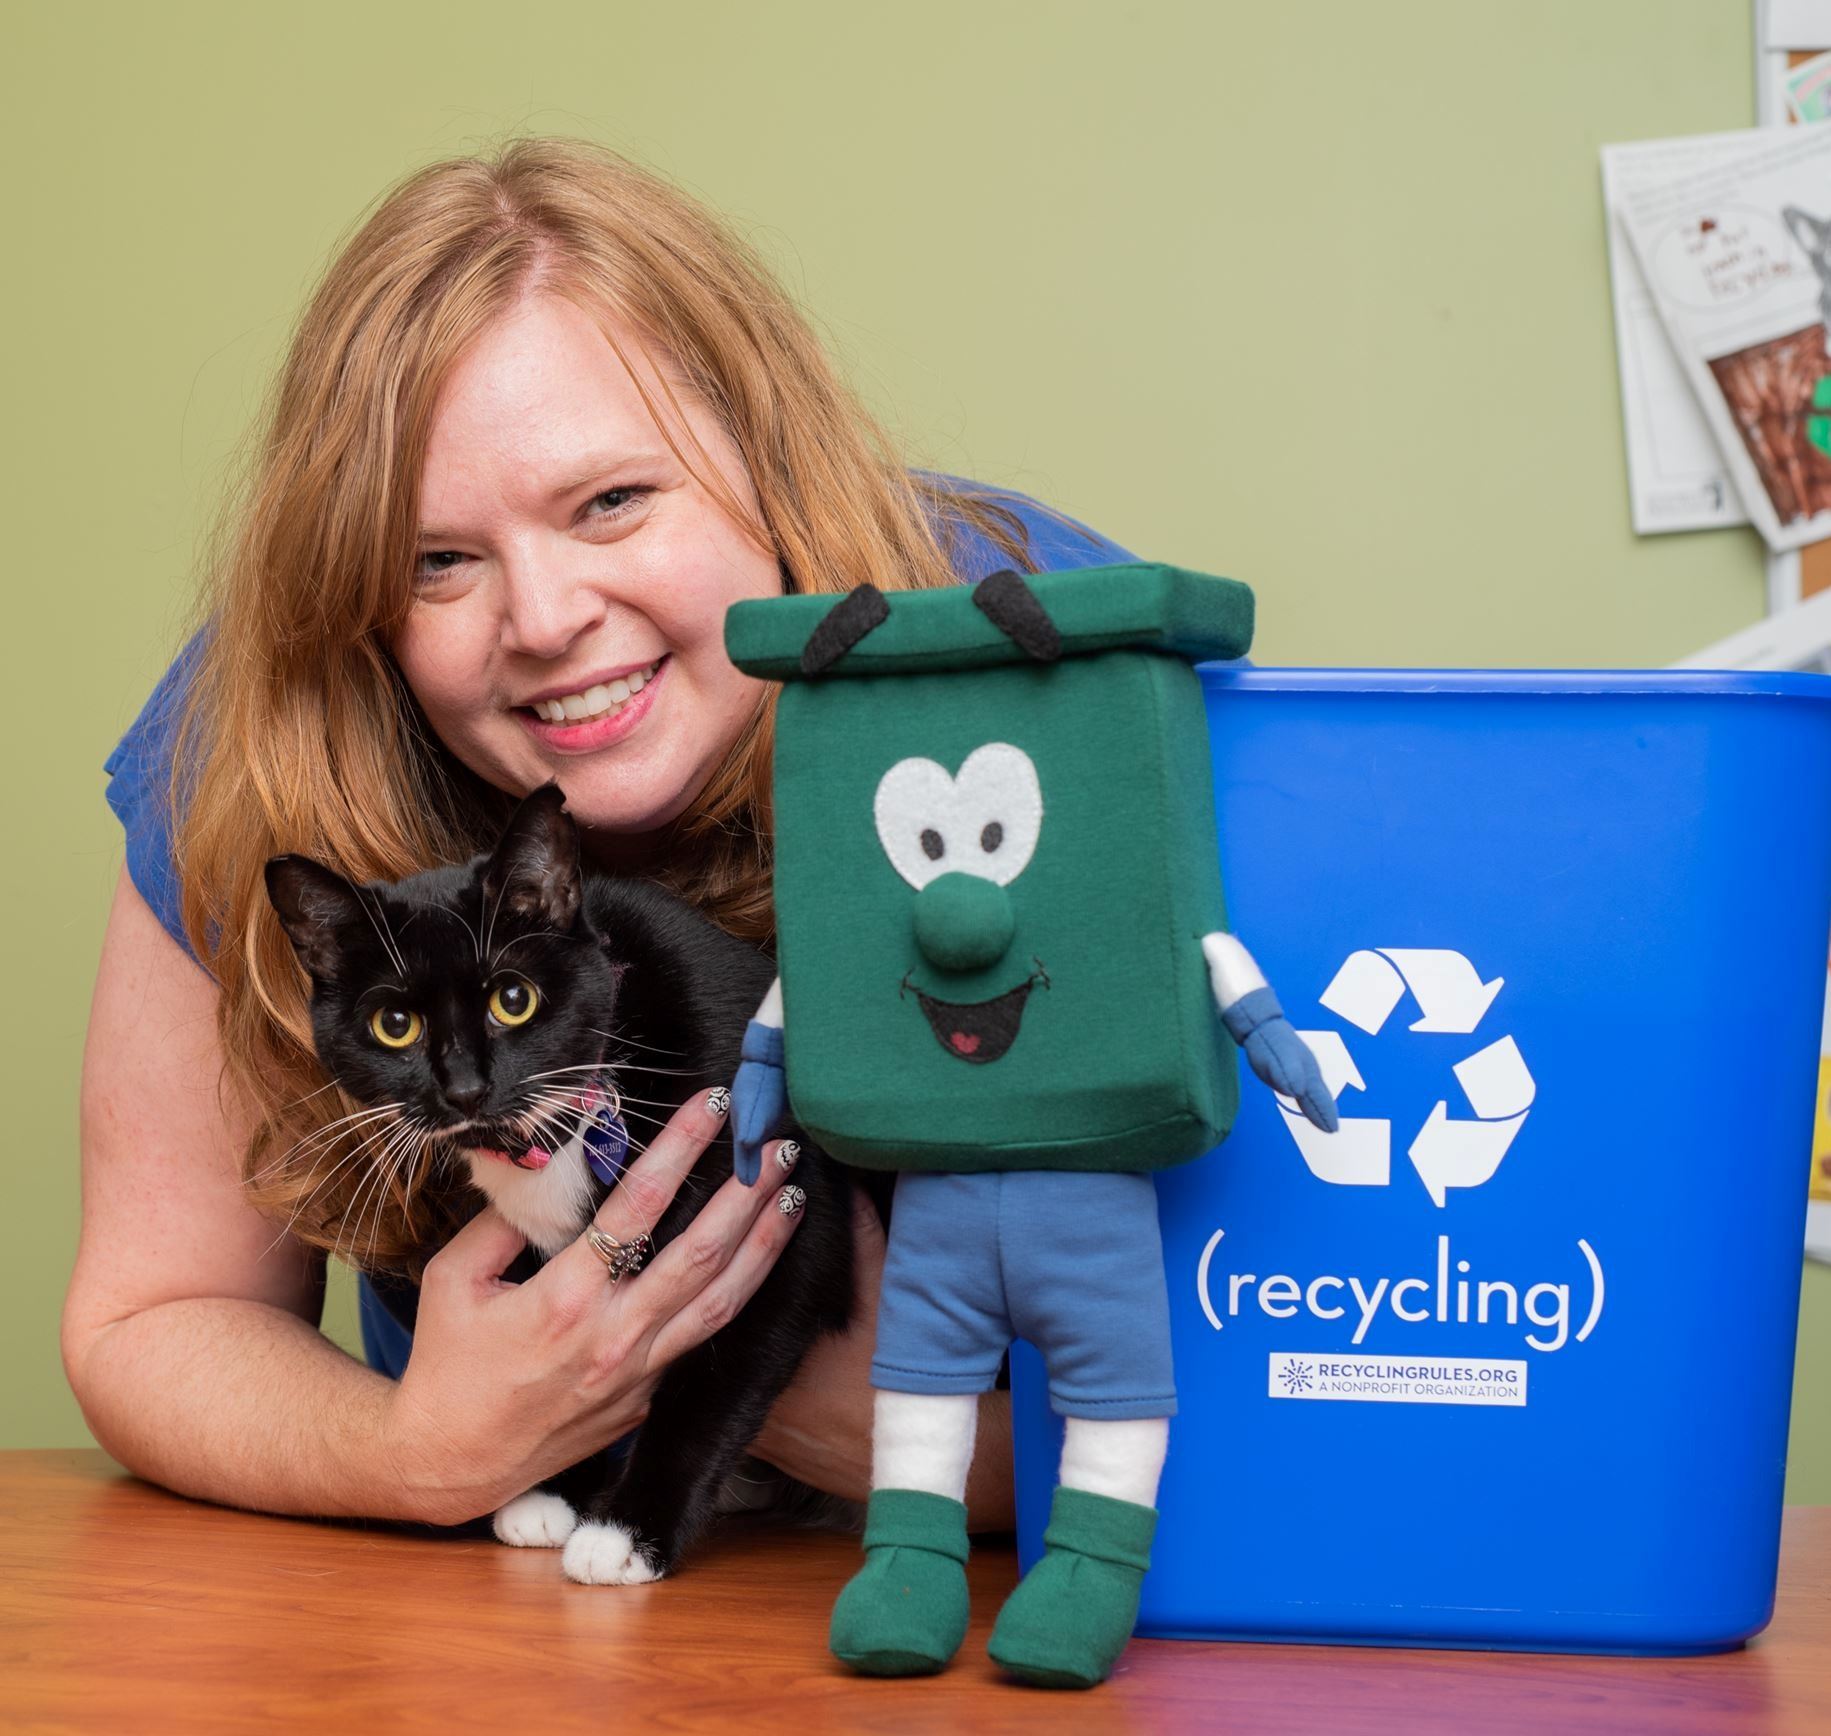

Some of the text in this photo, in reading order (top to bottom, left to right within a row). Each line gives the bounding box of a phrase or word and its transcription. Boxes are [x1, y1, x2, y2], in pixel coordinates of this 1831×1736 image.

[1197, 1228, 1605, 1352] (recycling)
[1318, 1363, 1519, 1383] RECYCLINGRULES.ORG
[1318, 1381, 1519, 1398] A NONPROFIT ORGANIZATION
